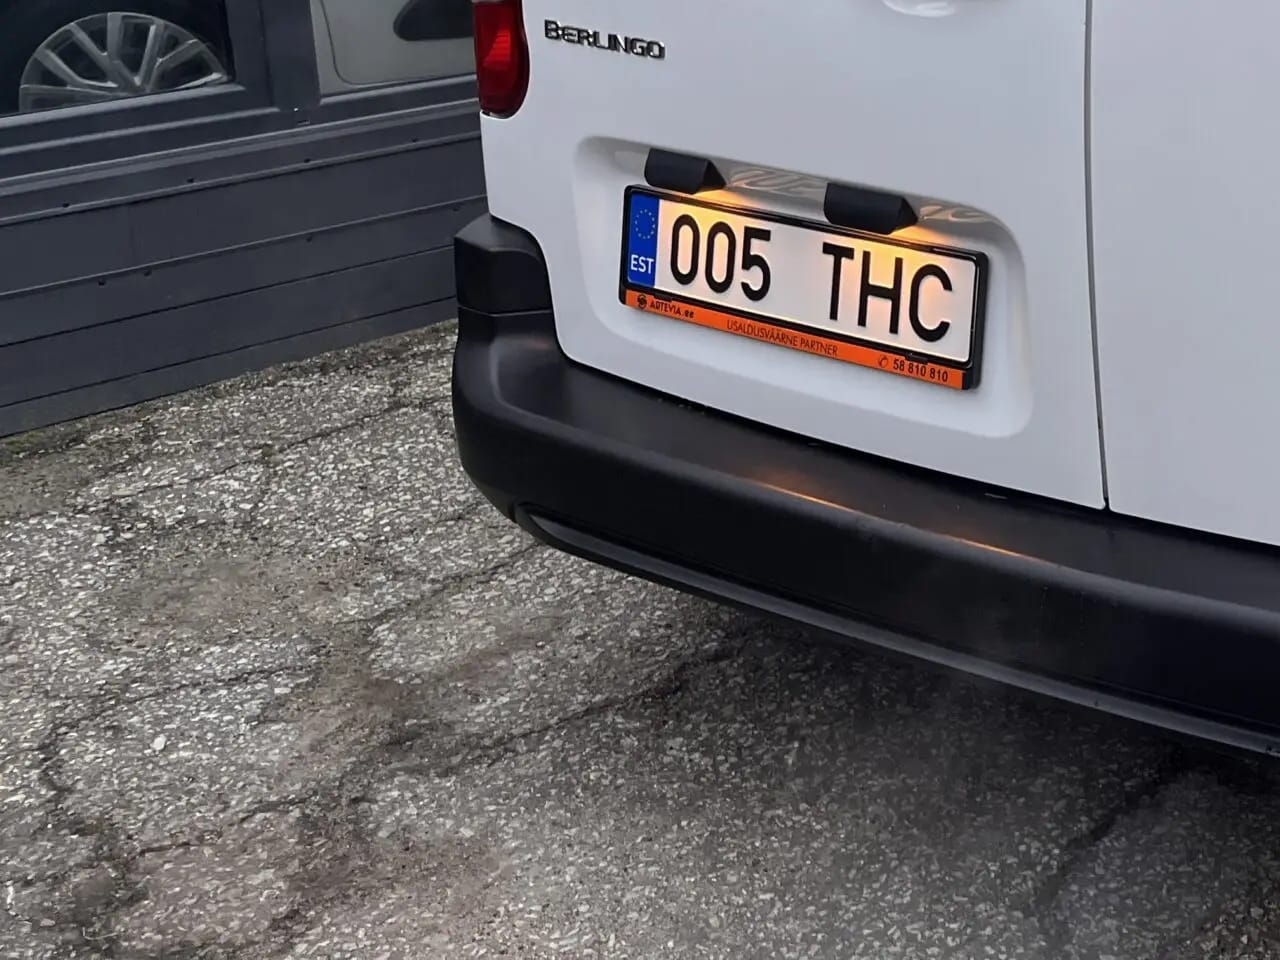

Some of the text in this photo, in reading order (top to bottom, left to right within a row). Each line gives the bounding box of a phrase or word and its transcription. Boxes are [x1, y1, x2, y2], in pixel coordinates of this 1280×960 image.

[544, 19, 665, 60] BERLINGO
[630, 254, 655, 274] EST
[670, 213, 953, 342] 005 THC
[800, 337, 838, 356] PARTNER
[893, 358, 948, 383] 58 810 810
